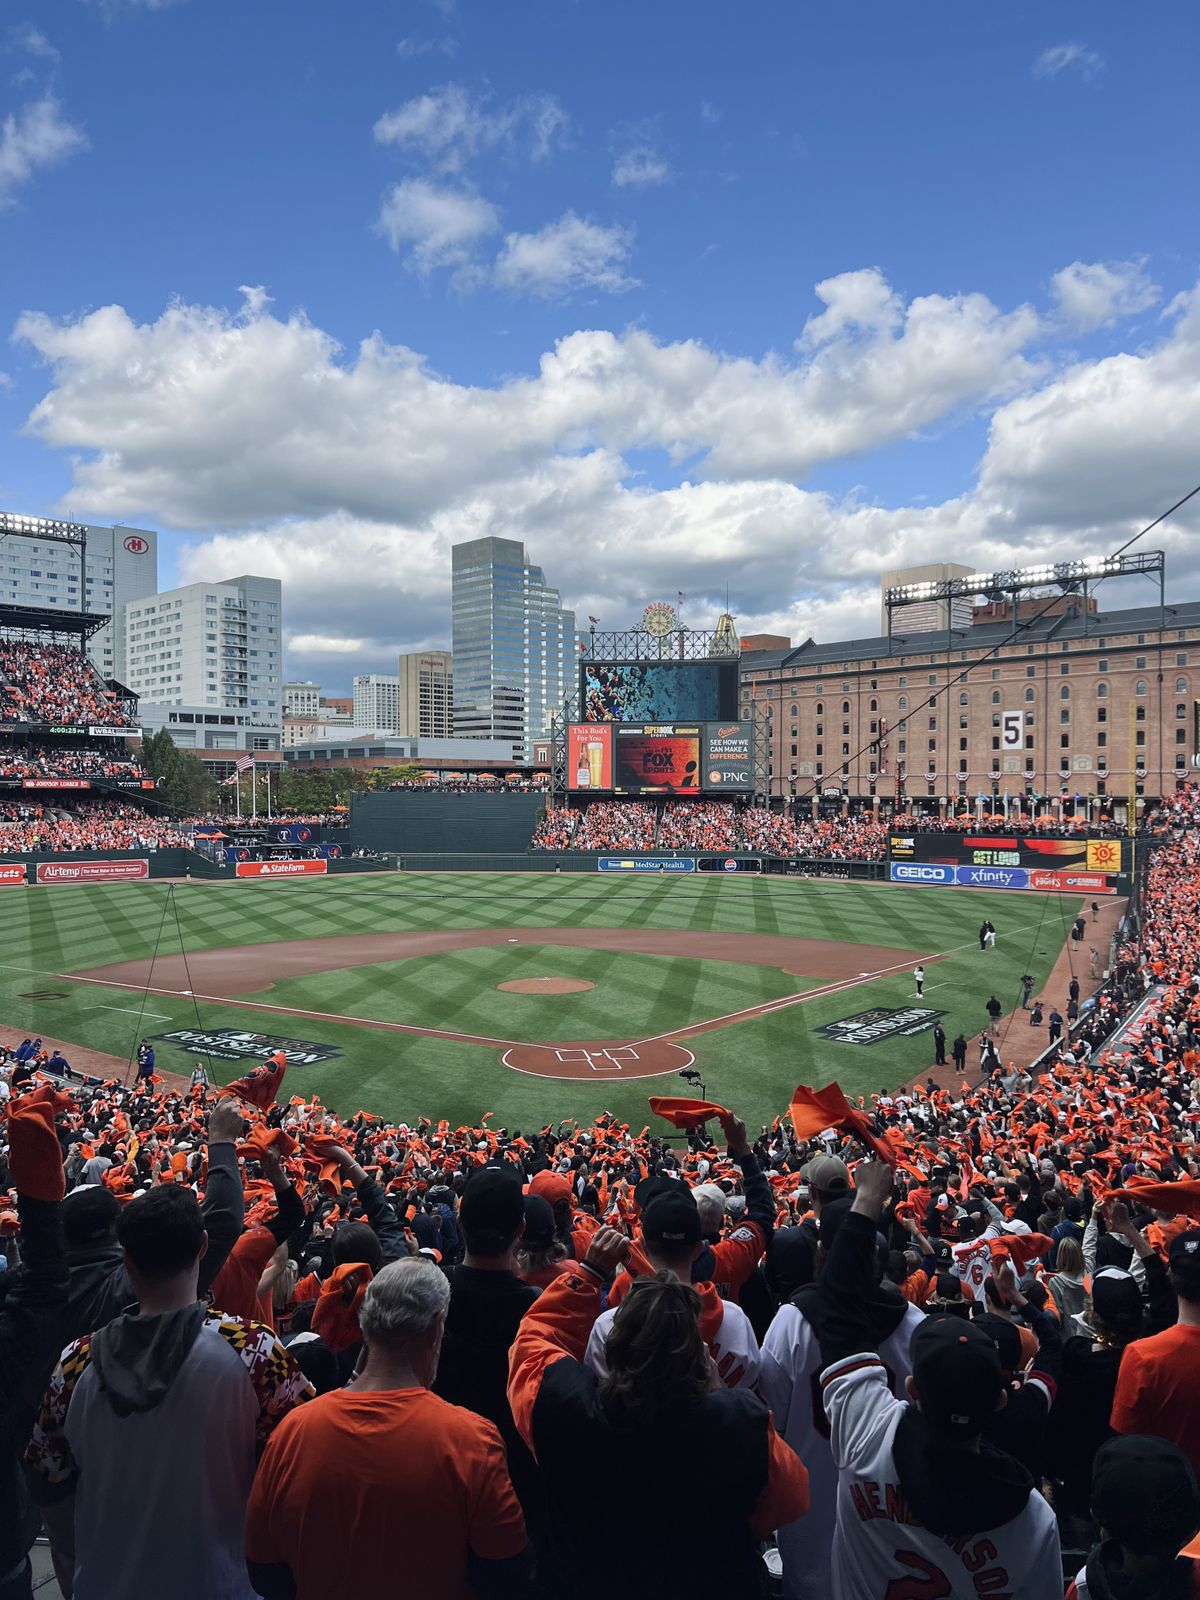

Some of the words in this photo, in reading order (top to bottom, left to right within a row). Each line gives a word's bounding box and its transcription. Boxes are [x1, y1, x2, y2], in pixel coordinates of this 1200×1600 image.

[1004, 716, 1020, 744] 5
[643, 752, 674, 767] FOX
[723, 772, 748, 782] PNC
[44, 866, 80, 877] Airtemp
[897, 866, 945, 880] GEICO
[970, 869, 1013, 885] xfinity
[835, 1008, 936, 1043] POSTSEASON
[971, 1264, 983, 1285] 6
